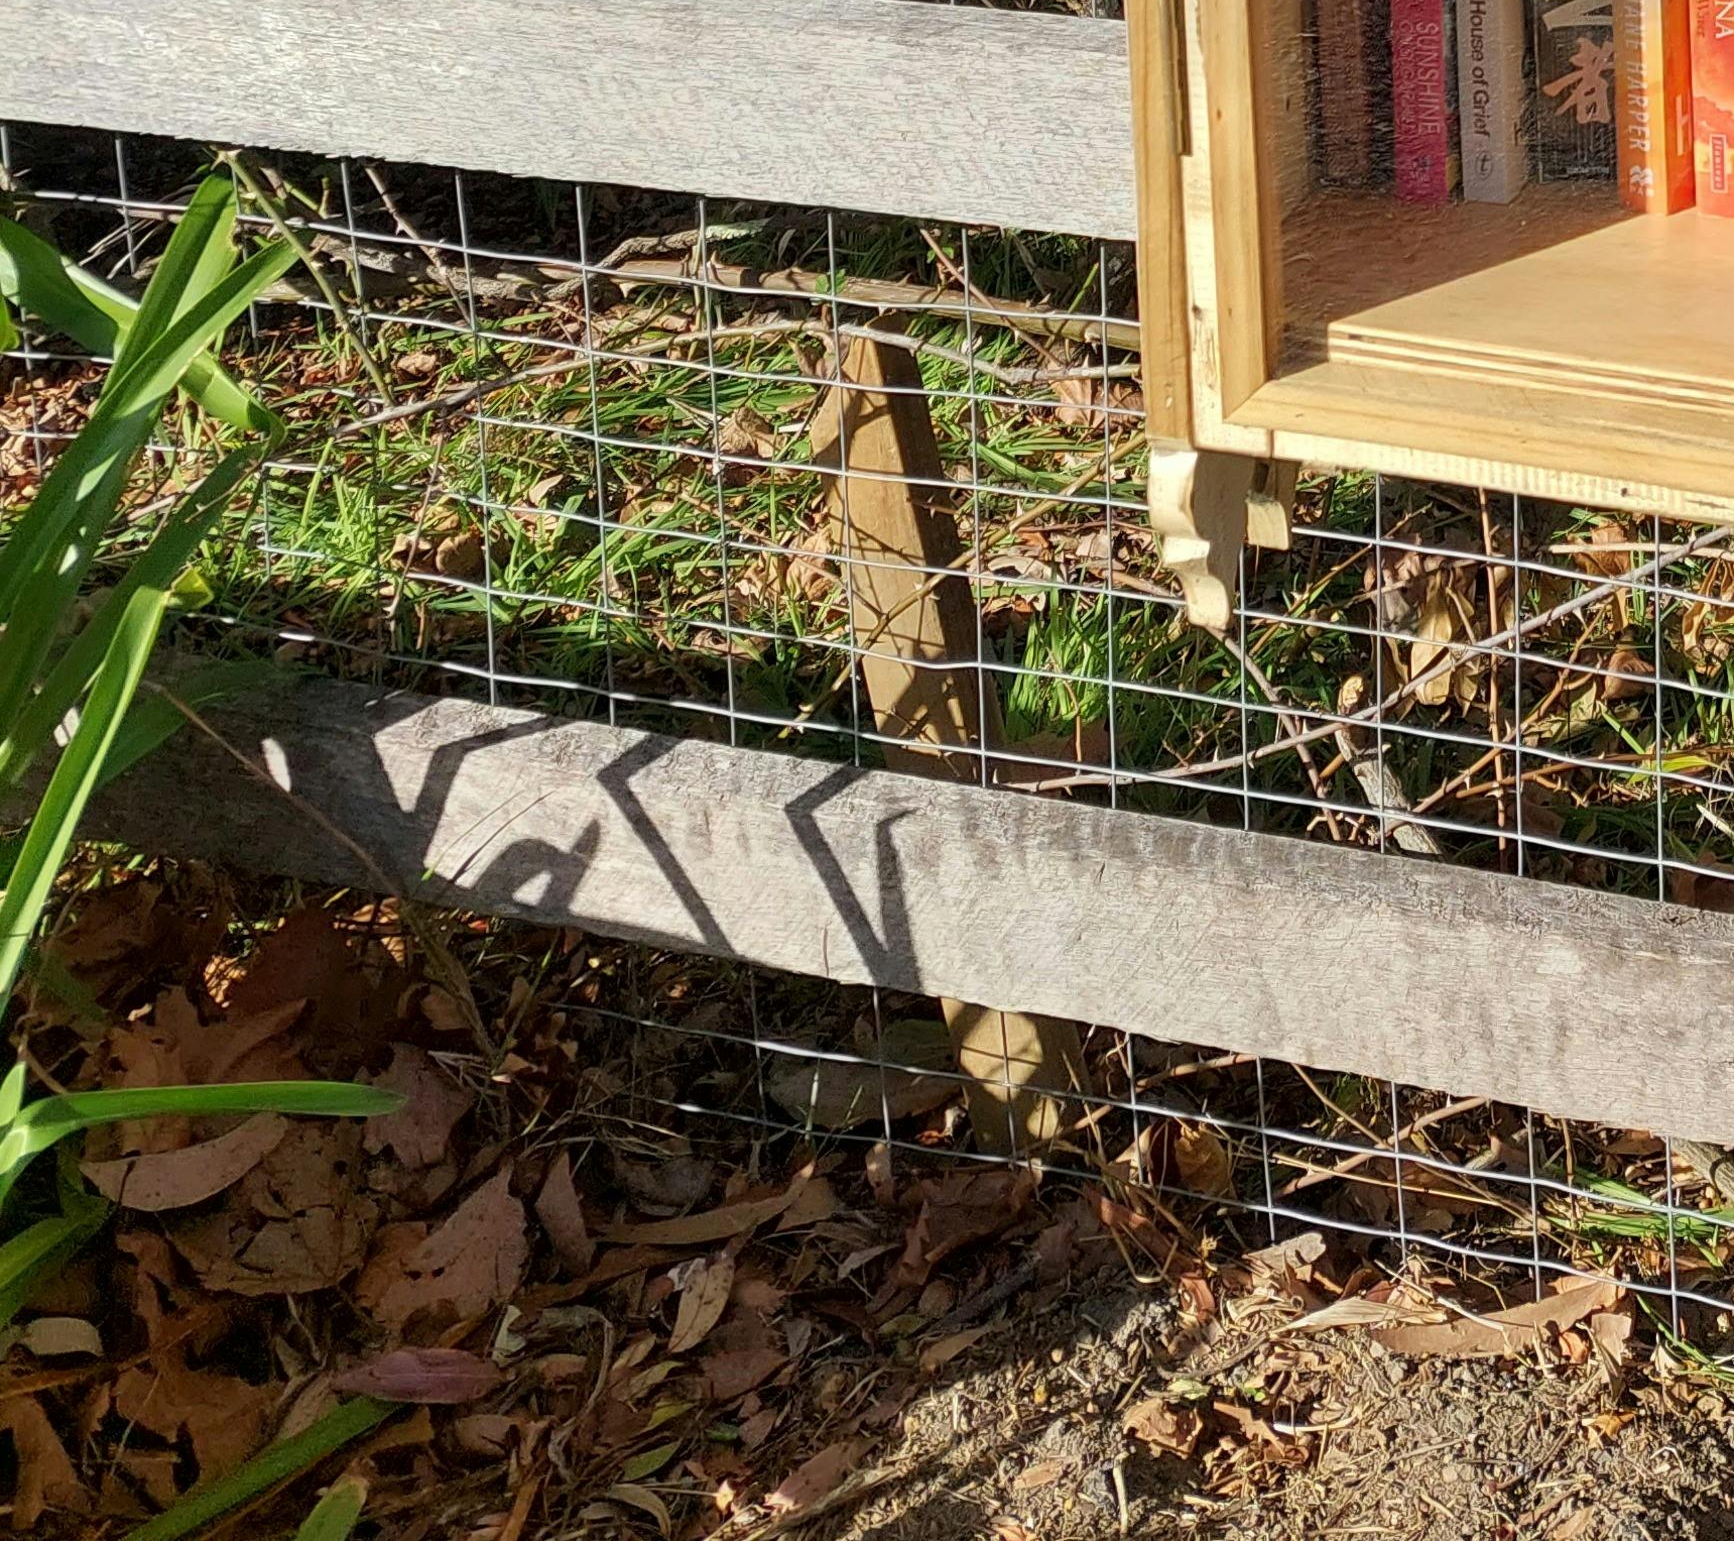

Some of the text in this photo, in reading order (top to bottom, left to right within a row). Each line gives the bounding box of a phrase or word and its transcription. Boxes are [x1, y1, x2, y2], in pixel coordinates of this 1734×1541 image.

[1469, 0, 1490, 63] House
[1416, 22, 1441, 135] SUNSHINE
[1471, 66, 1490, 87] of
[1624, 58, 1653, 154] HARPER
[1473, 88, 1493, 138] Grief
